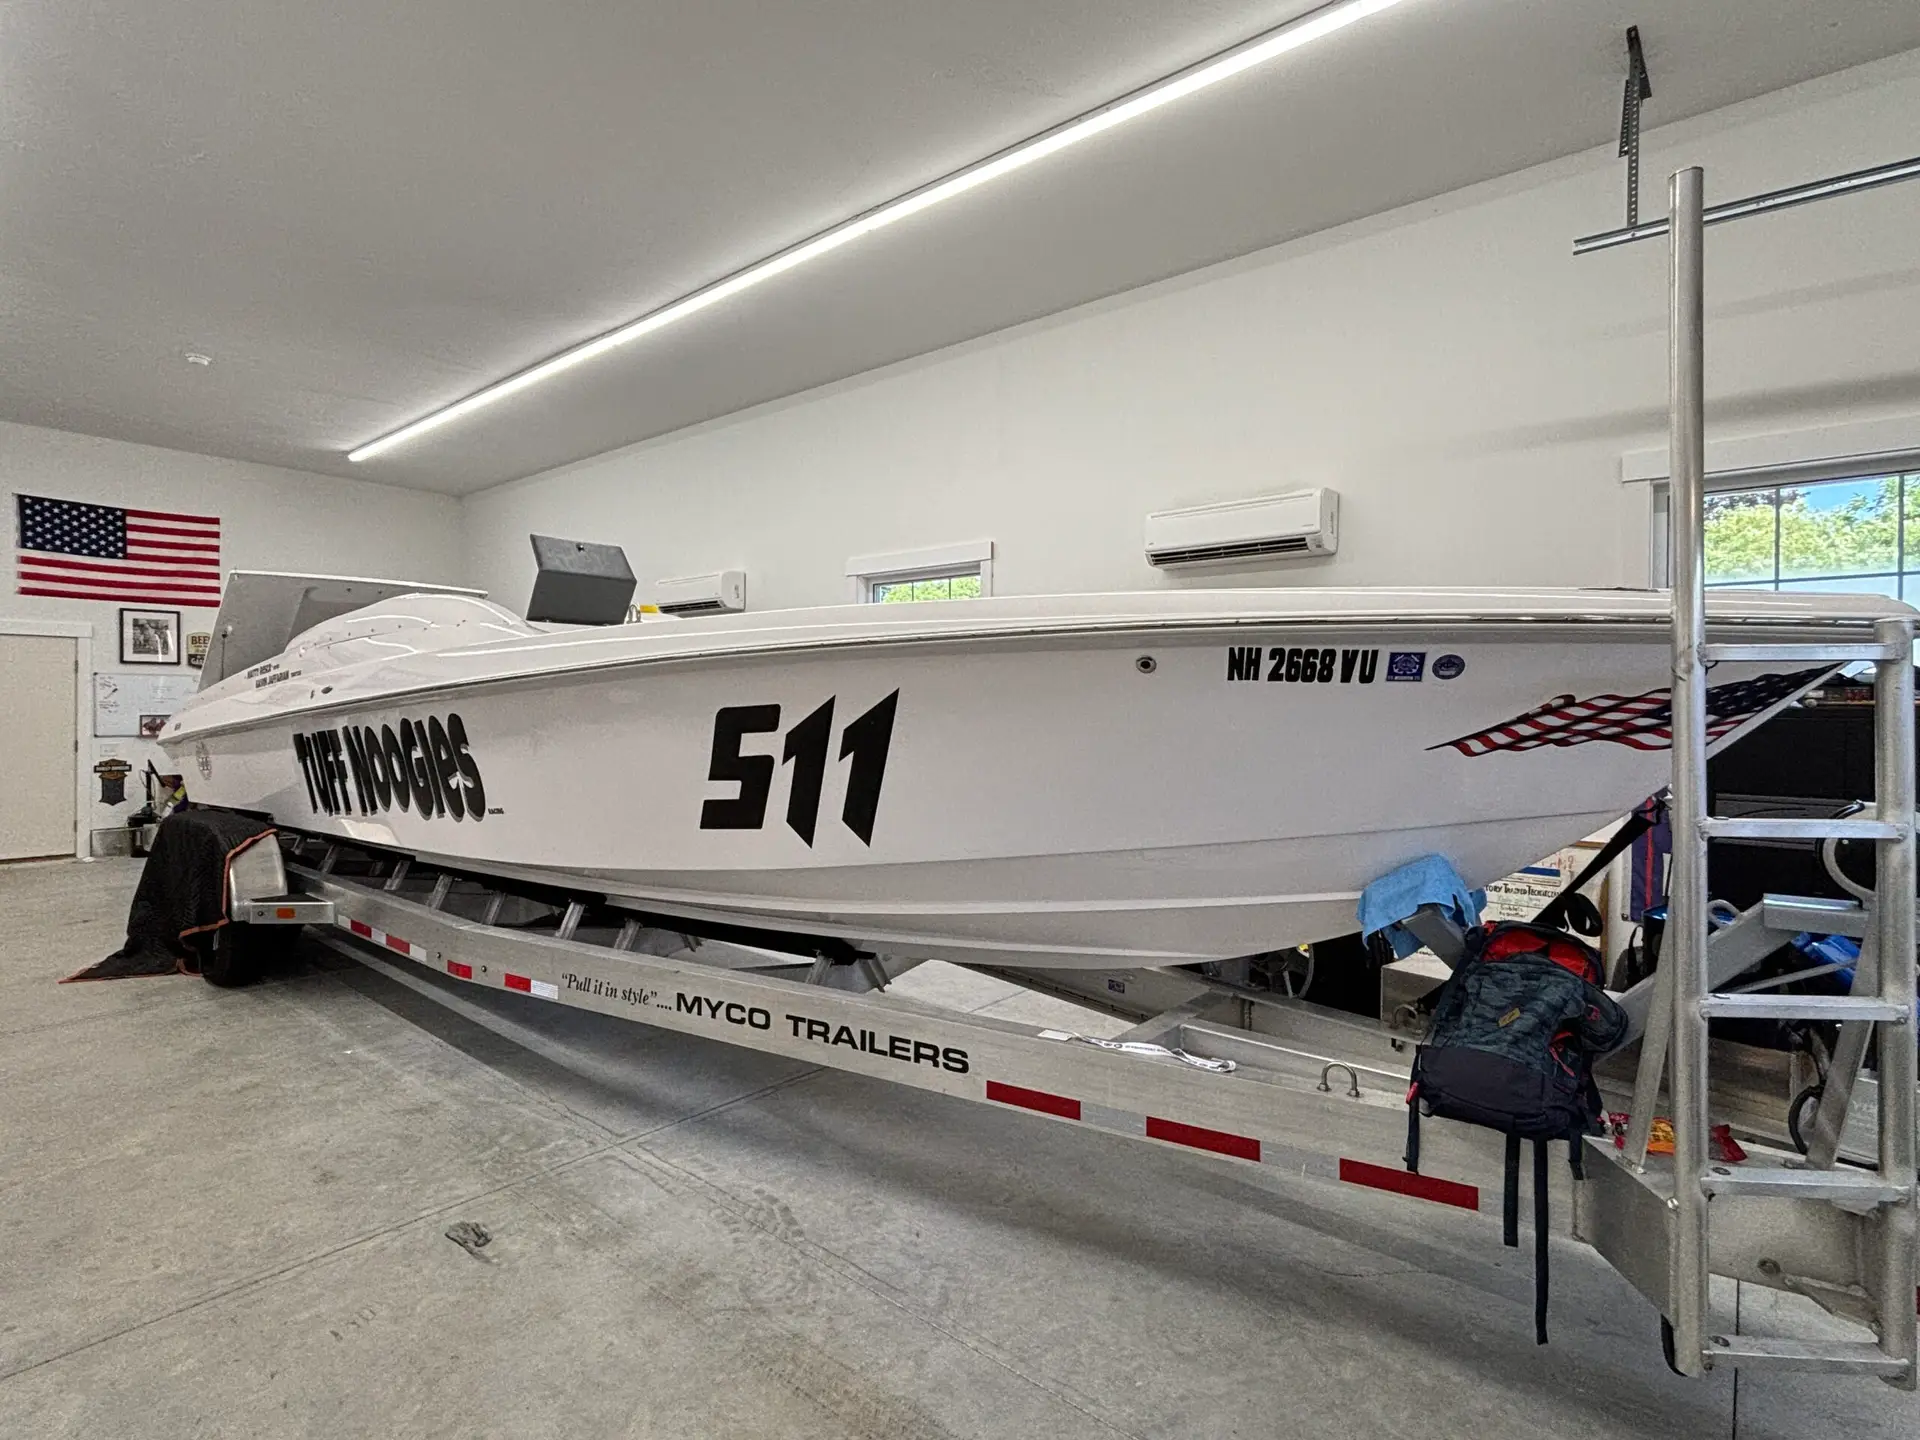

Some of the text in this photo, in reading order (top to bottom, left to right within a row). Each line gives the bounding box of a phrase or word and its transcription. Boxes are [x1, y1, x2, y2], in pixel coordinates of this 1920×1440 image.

[191, 635, 211, 645] BEE
[1227, 647, 1380, 684] NH 2668 VU
[293, 729, 352, 817] TUFF
[700, 687, 900, 849] 511
[594, 979, 603, 996] it
[605, 982, 618, 999] in
[676, 992, 771, 1030] MYCO
[785, 1014, 970, 1074] TRAILERS
